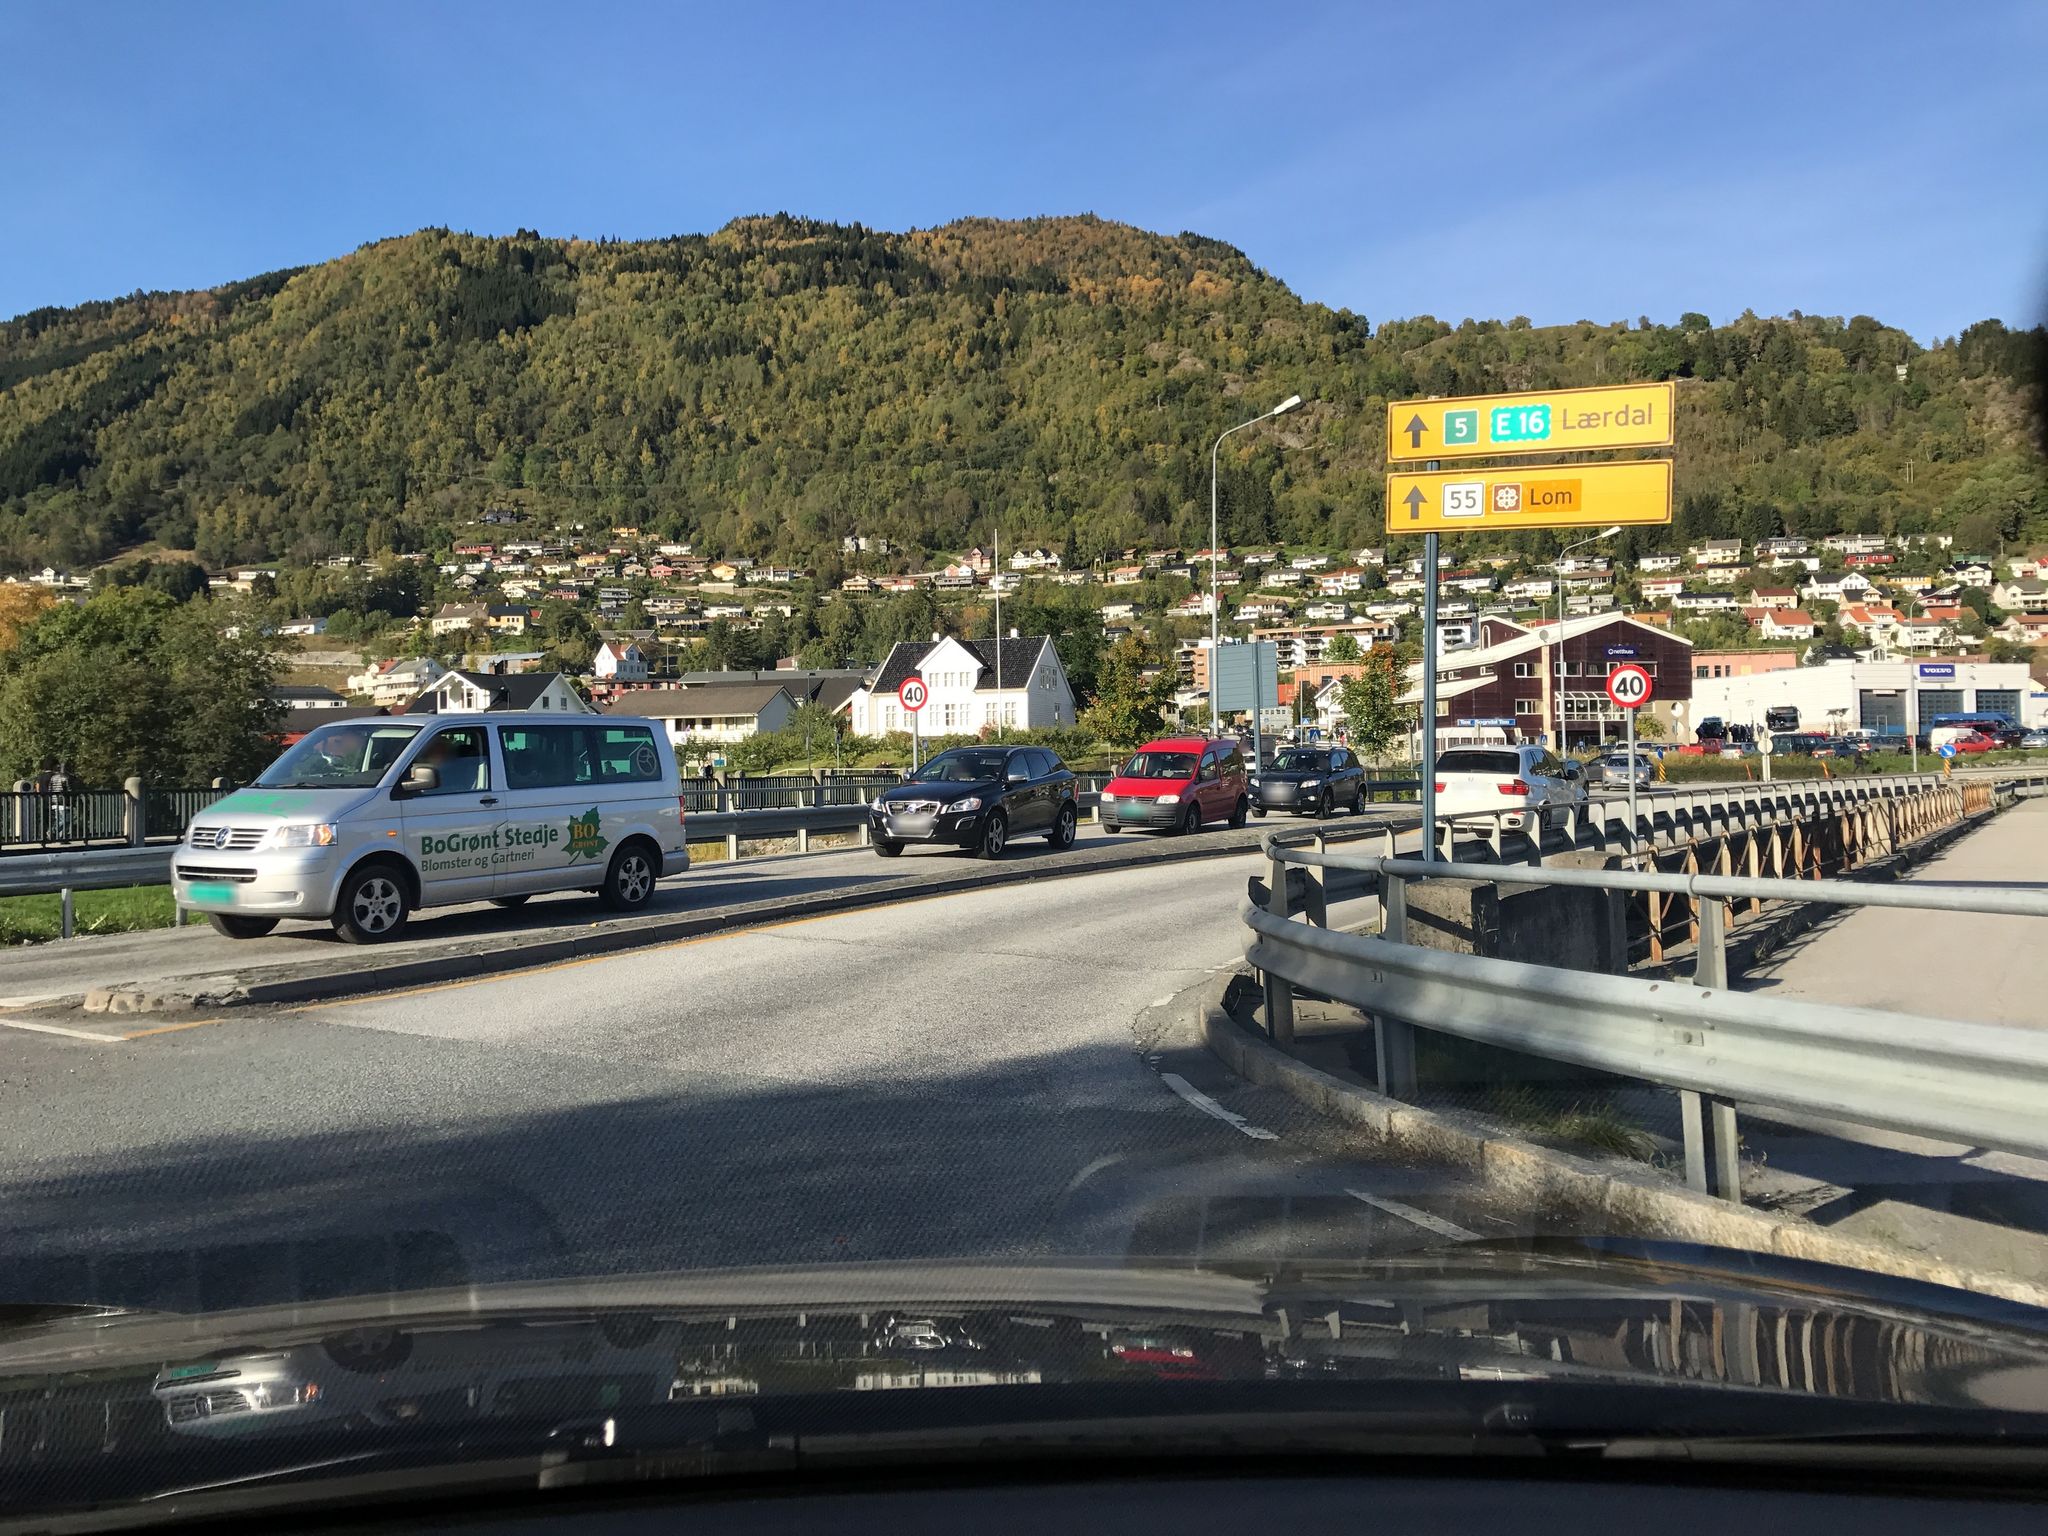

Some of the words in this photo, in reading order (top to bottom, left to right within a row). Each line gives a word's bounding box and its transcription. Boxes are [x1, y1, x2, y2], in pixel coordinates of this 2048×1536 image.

[1455, 417, 1468, 438] 5
[1496, 412, 1511, 436] E
[1519, 410, 1545, 434] 16
[1562, 402, 1653, 430] Lærdal
[1450, 489, 1477, 510] 55
[1530, 488, 1572, 506] Lom
[904, 686, 923, 702] 40
[1615, 675, 1644, 696] 40
[421, 830, 500, 856] BoGrønt
[505, 824, 559, 849] Stedje
[573, 823, 595, 839] BO
[421, 856, 471, 872] Blomster
[474, 854, 489, 869] og
[491, 848, 535, 864] Gartneri
